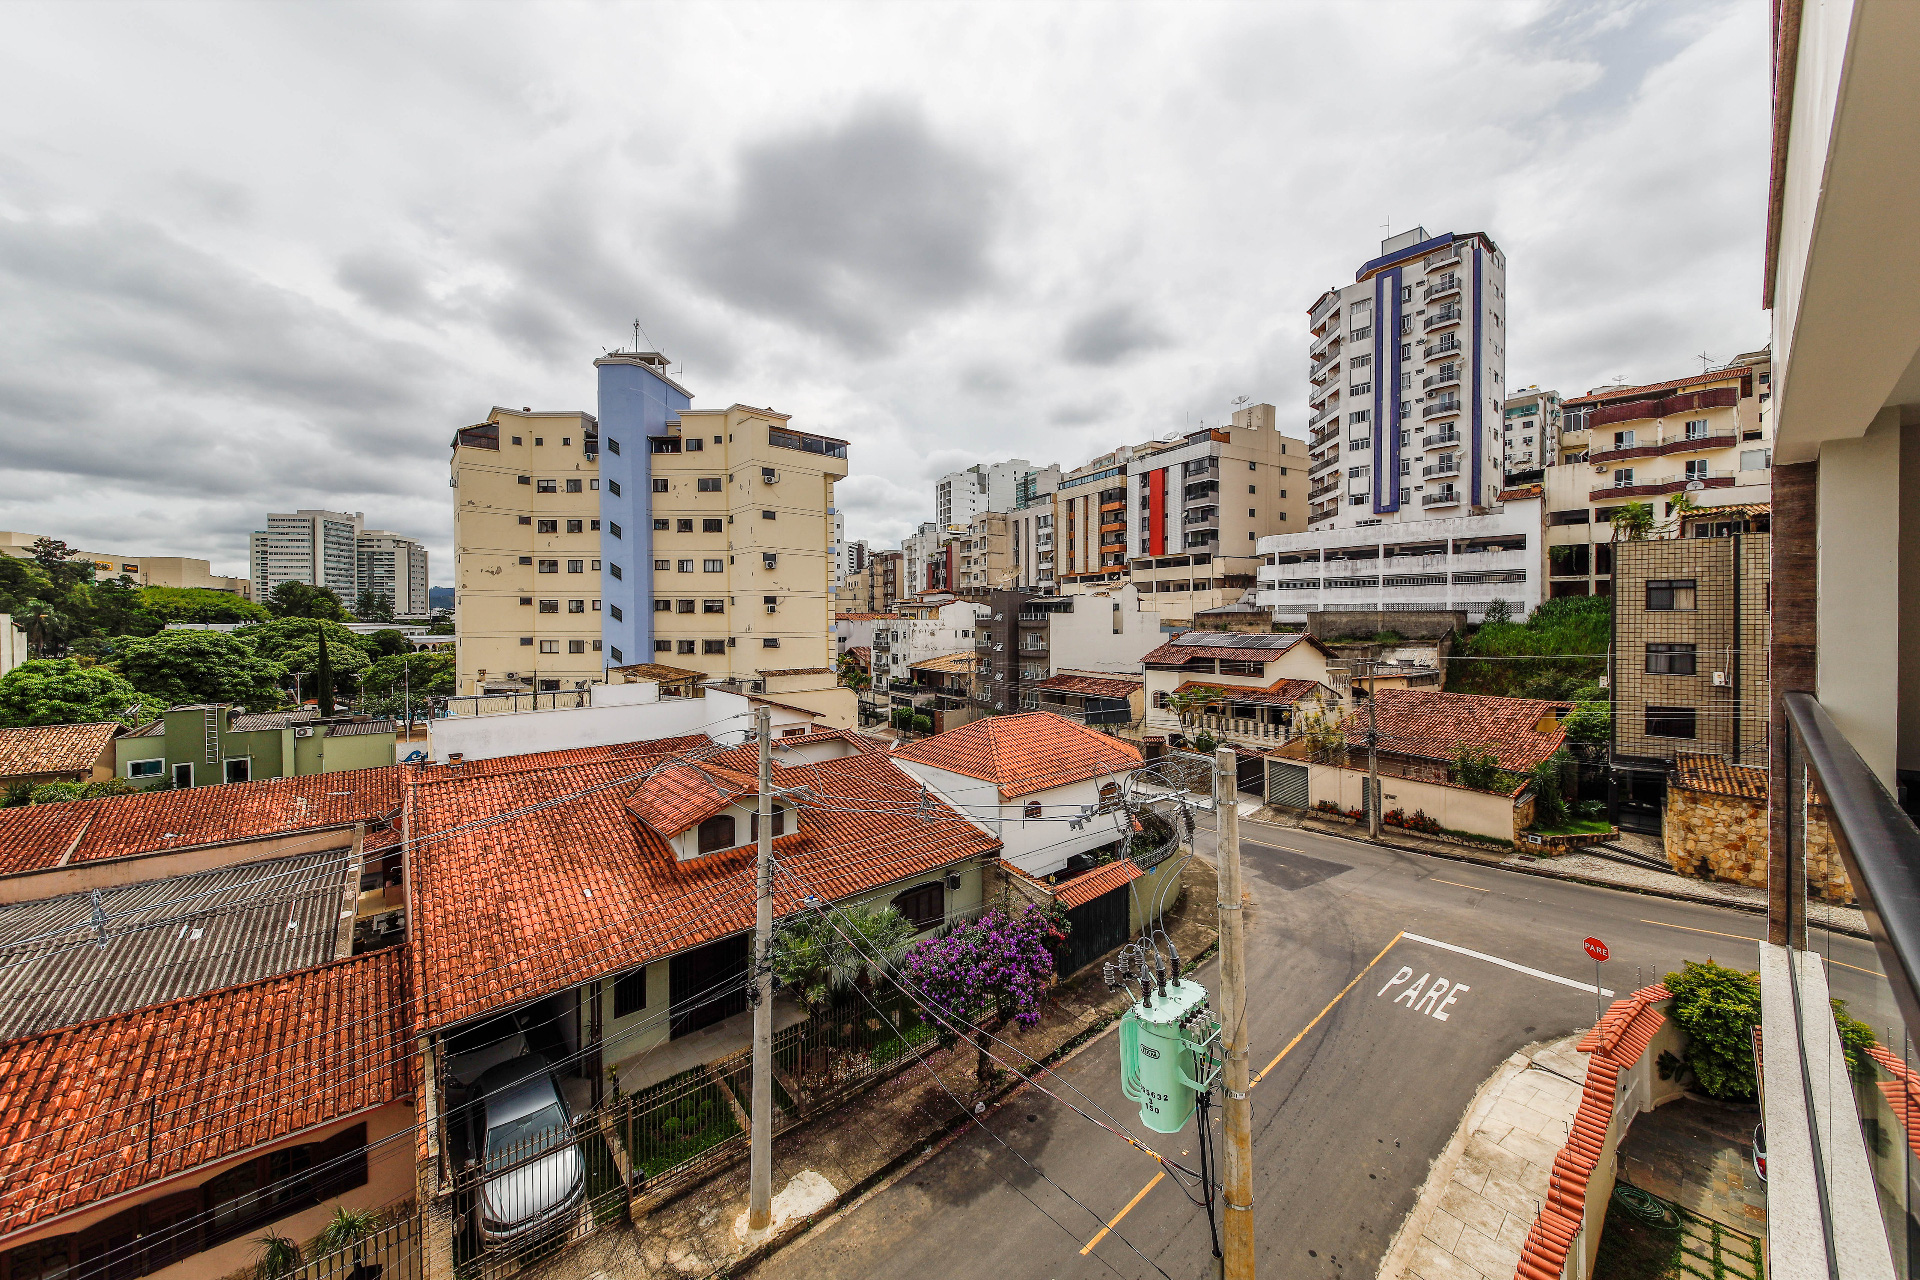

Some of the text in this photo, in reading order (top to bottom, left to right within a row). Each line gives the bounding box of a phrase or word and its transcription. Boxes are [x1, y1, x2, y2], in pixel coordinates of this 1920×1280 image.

[1584, 942, 1608, 957] PARE
[1377, 965, 1471, 1022] PARE
[1145, 1103, 1160, 1115] 150
